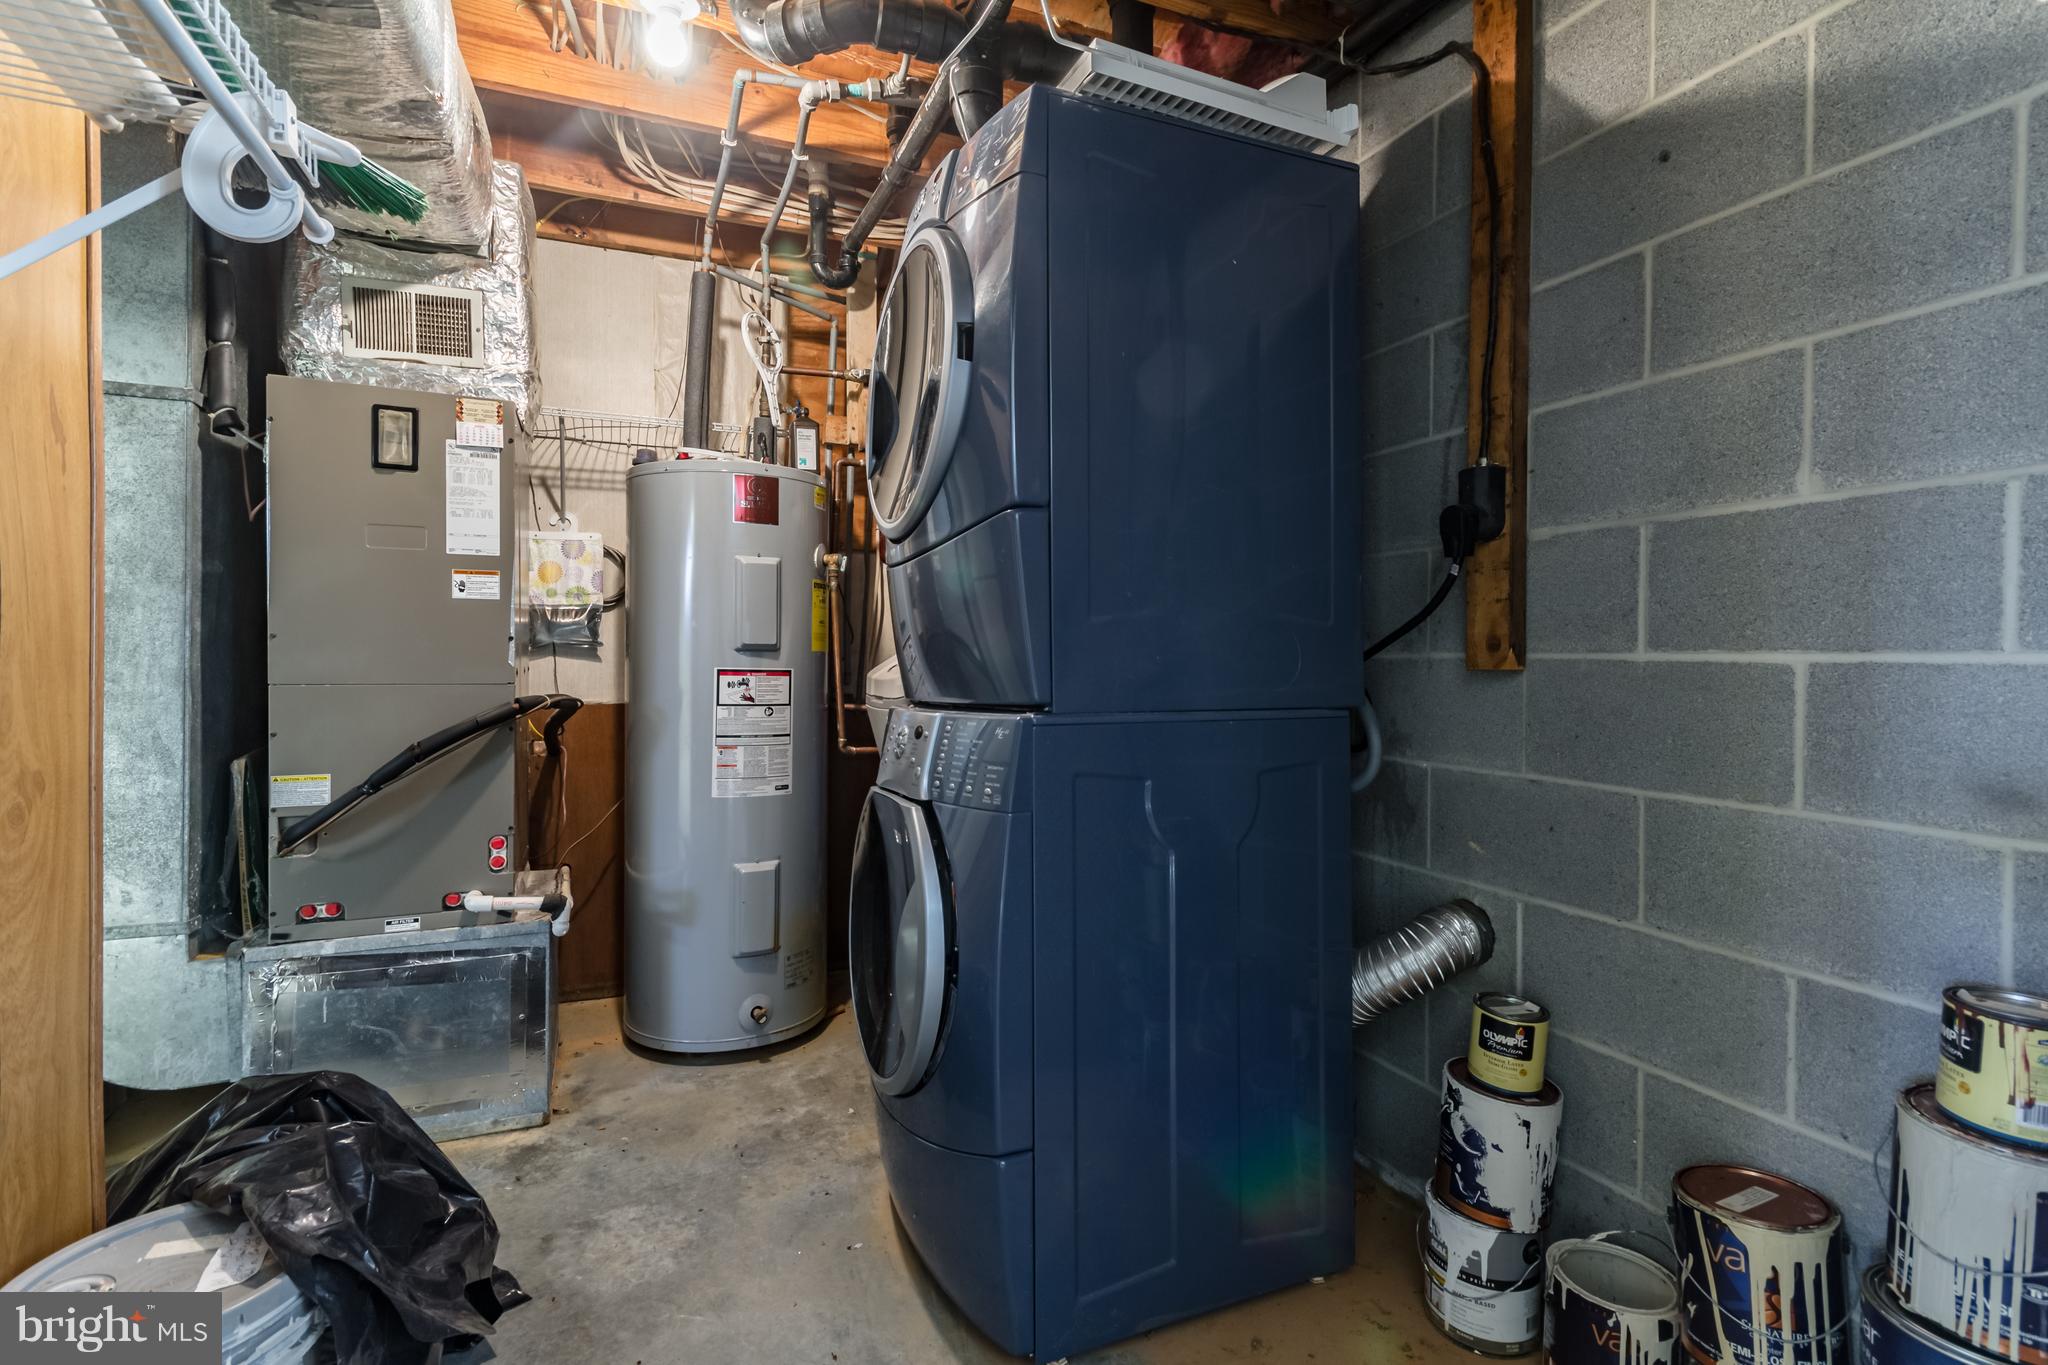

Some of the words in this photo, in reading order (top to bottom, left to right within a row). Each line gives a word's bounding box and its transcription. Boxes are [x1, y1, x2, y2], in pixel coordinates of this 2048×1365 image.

[1483, 1028, 1528, 1048] OLYMPIC
[1487, 1039, 1523, 1055] Premium
[1474, 1300, 1497, 1310] BASED
